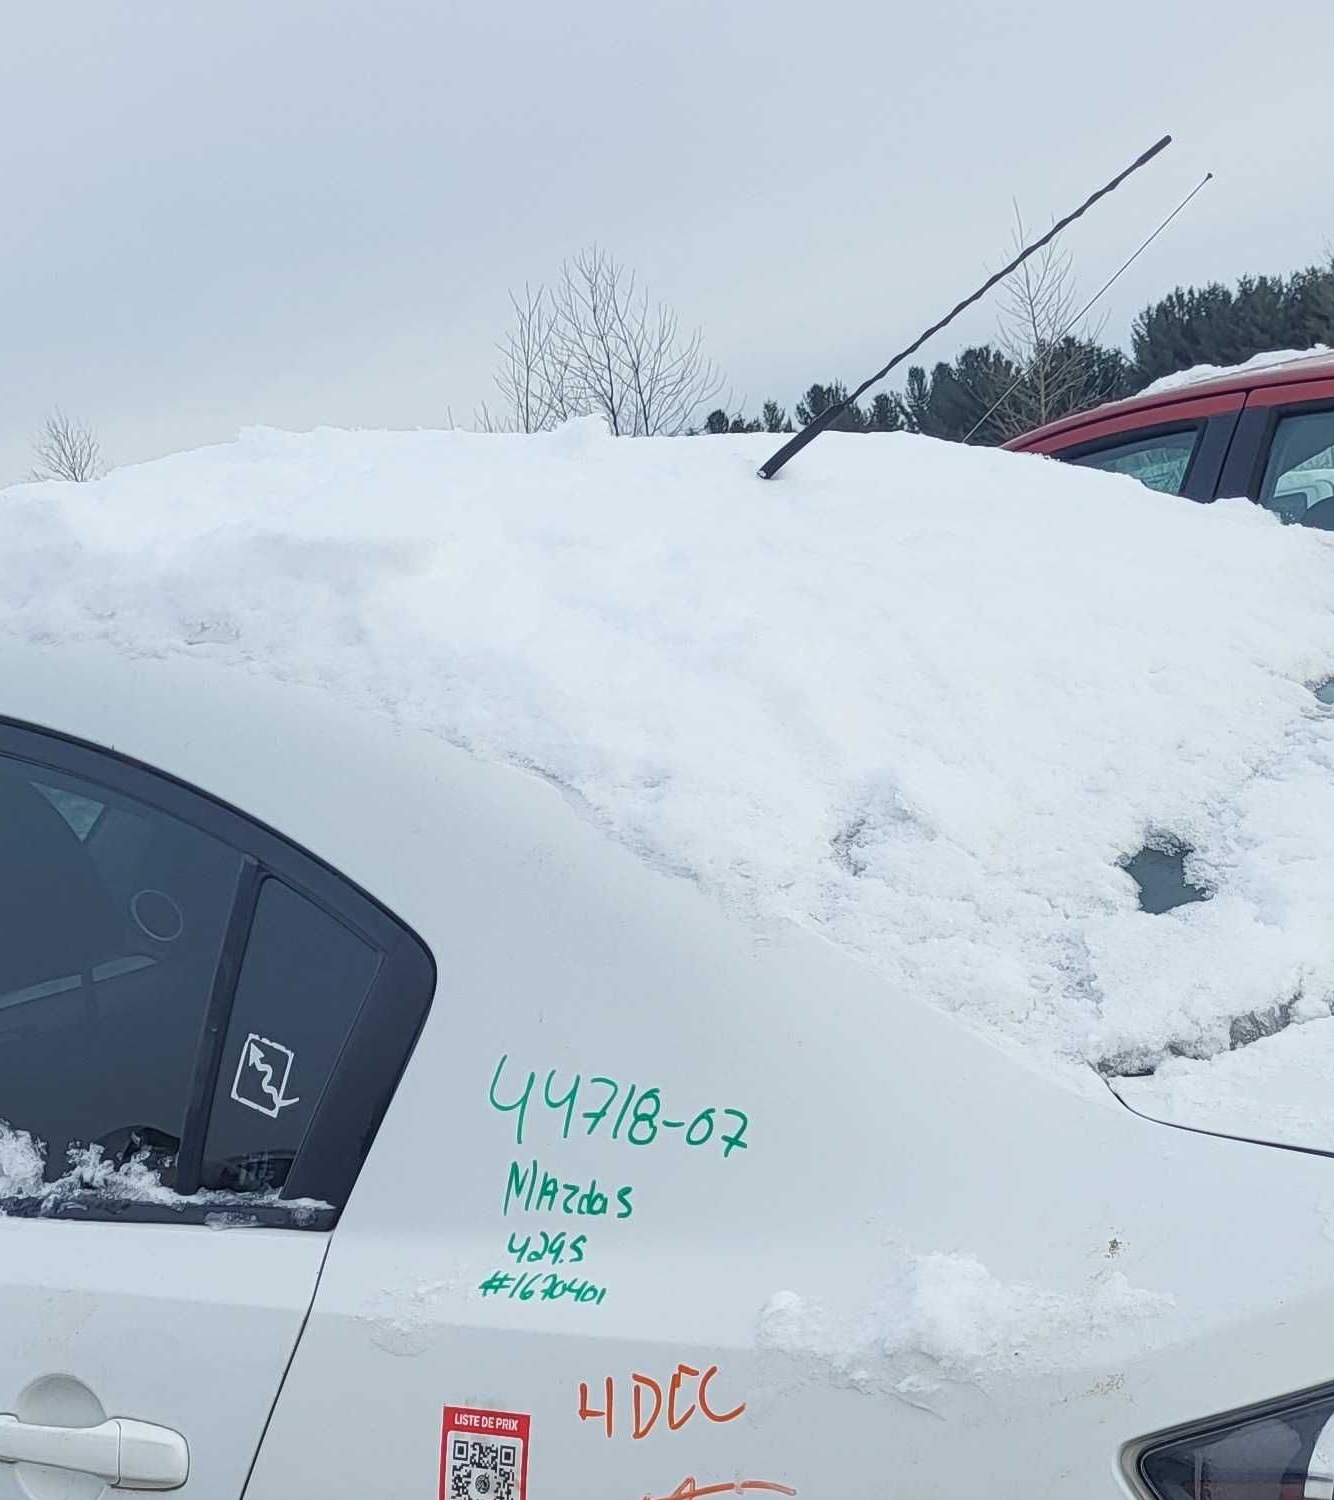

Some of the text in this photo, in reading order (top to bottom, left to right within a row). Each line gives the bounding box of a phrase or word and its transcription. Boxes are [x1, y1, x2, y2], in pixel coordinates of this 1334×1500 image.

[488, 1053, 749, 1158] 44718-07
[454, 1412, 519, 1432] LISTE DE PRIX
